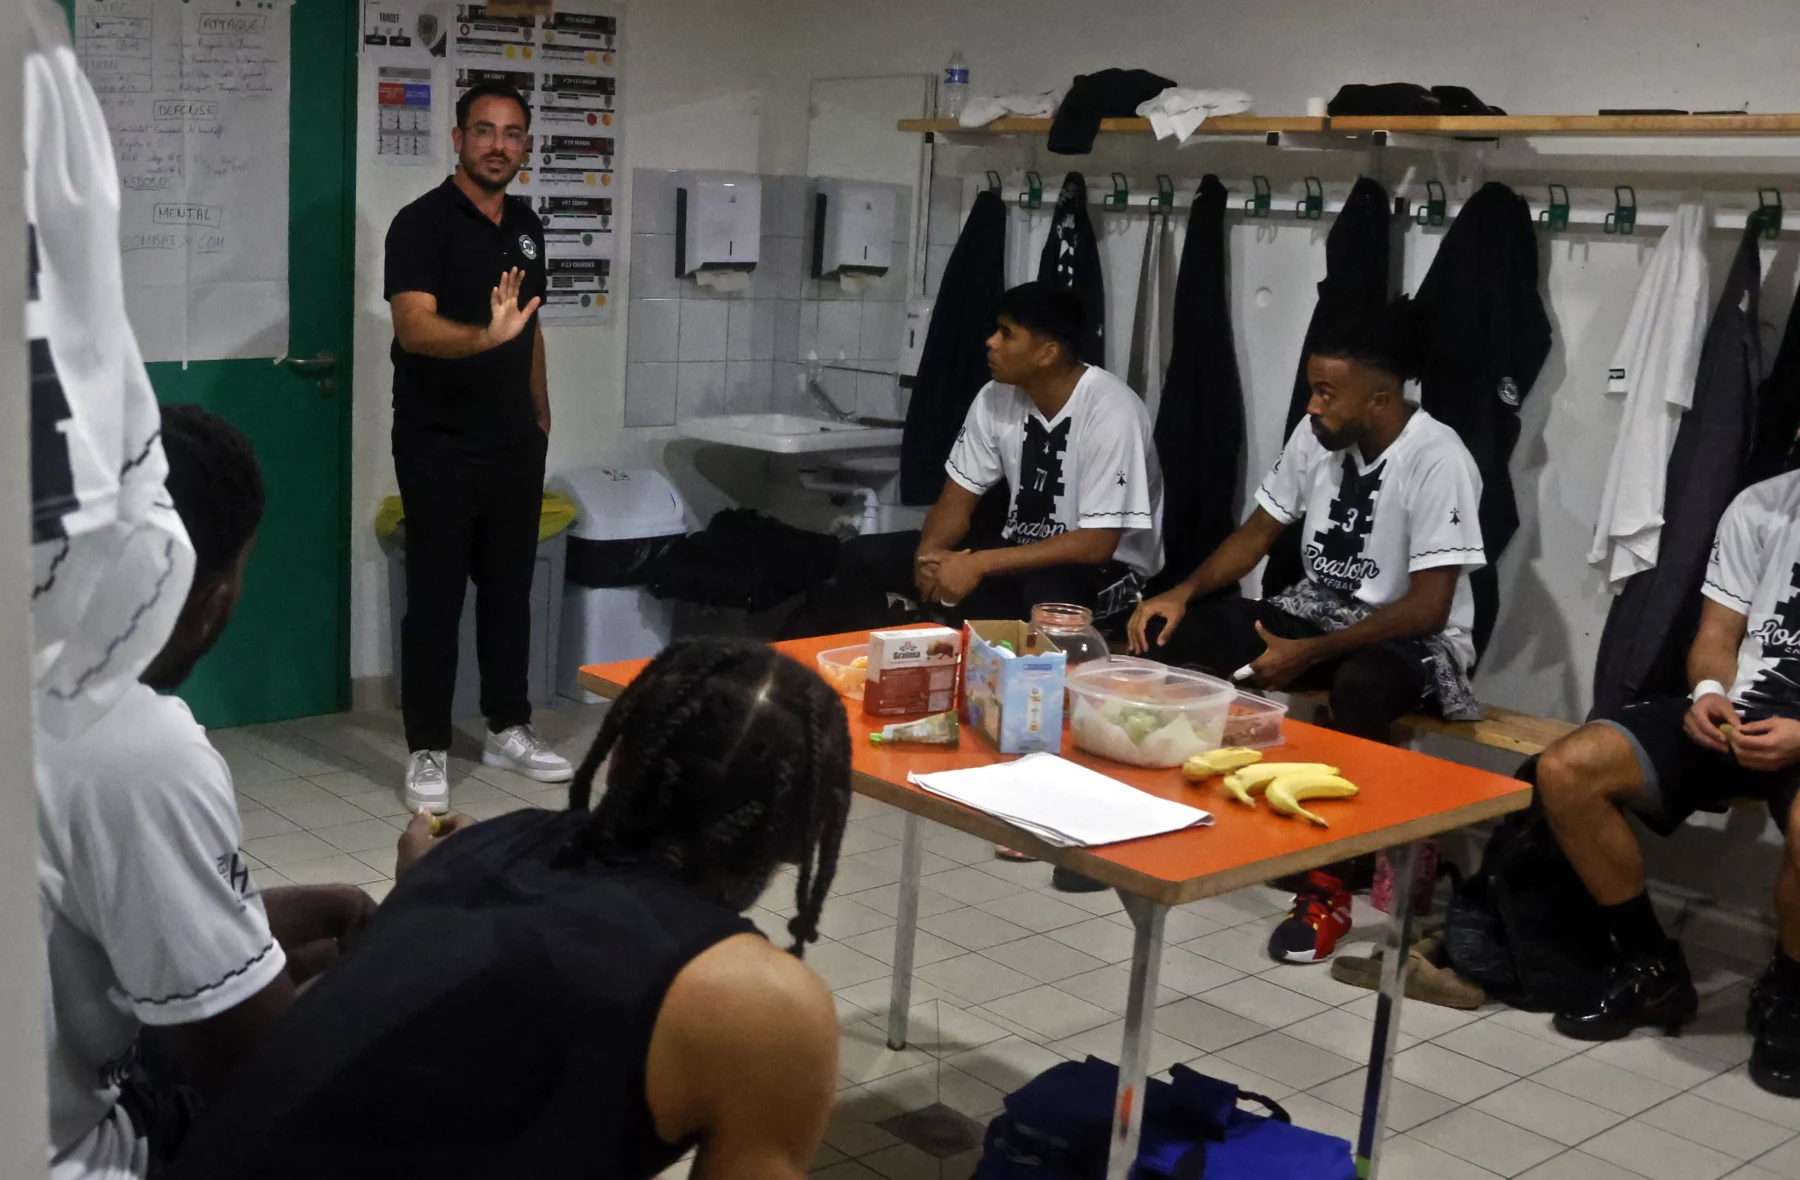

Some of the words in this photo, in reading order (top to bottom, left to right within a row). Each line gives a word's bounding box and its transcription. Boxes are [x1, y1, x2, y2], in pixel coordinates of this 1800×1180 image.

[204, 16, 258, 31] ATTAQUE
[379, 12, 400, 24] TARGET
[159, 104, 216, 117] DEFENSE
[158, 207, 211, 221] MENTAL
[1341, 507, 1359, 533] 3
